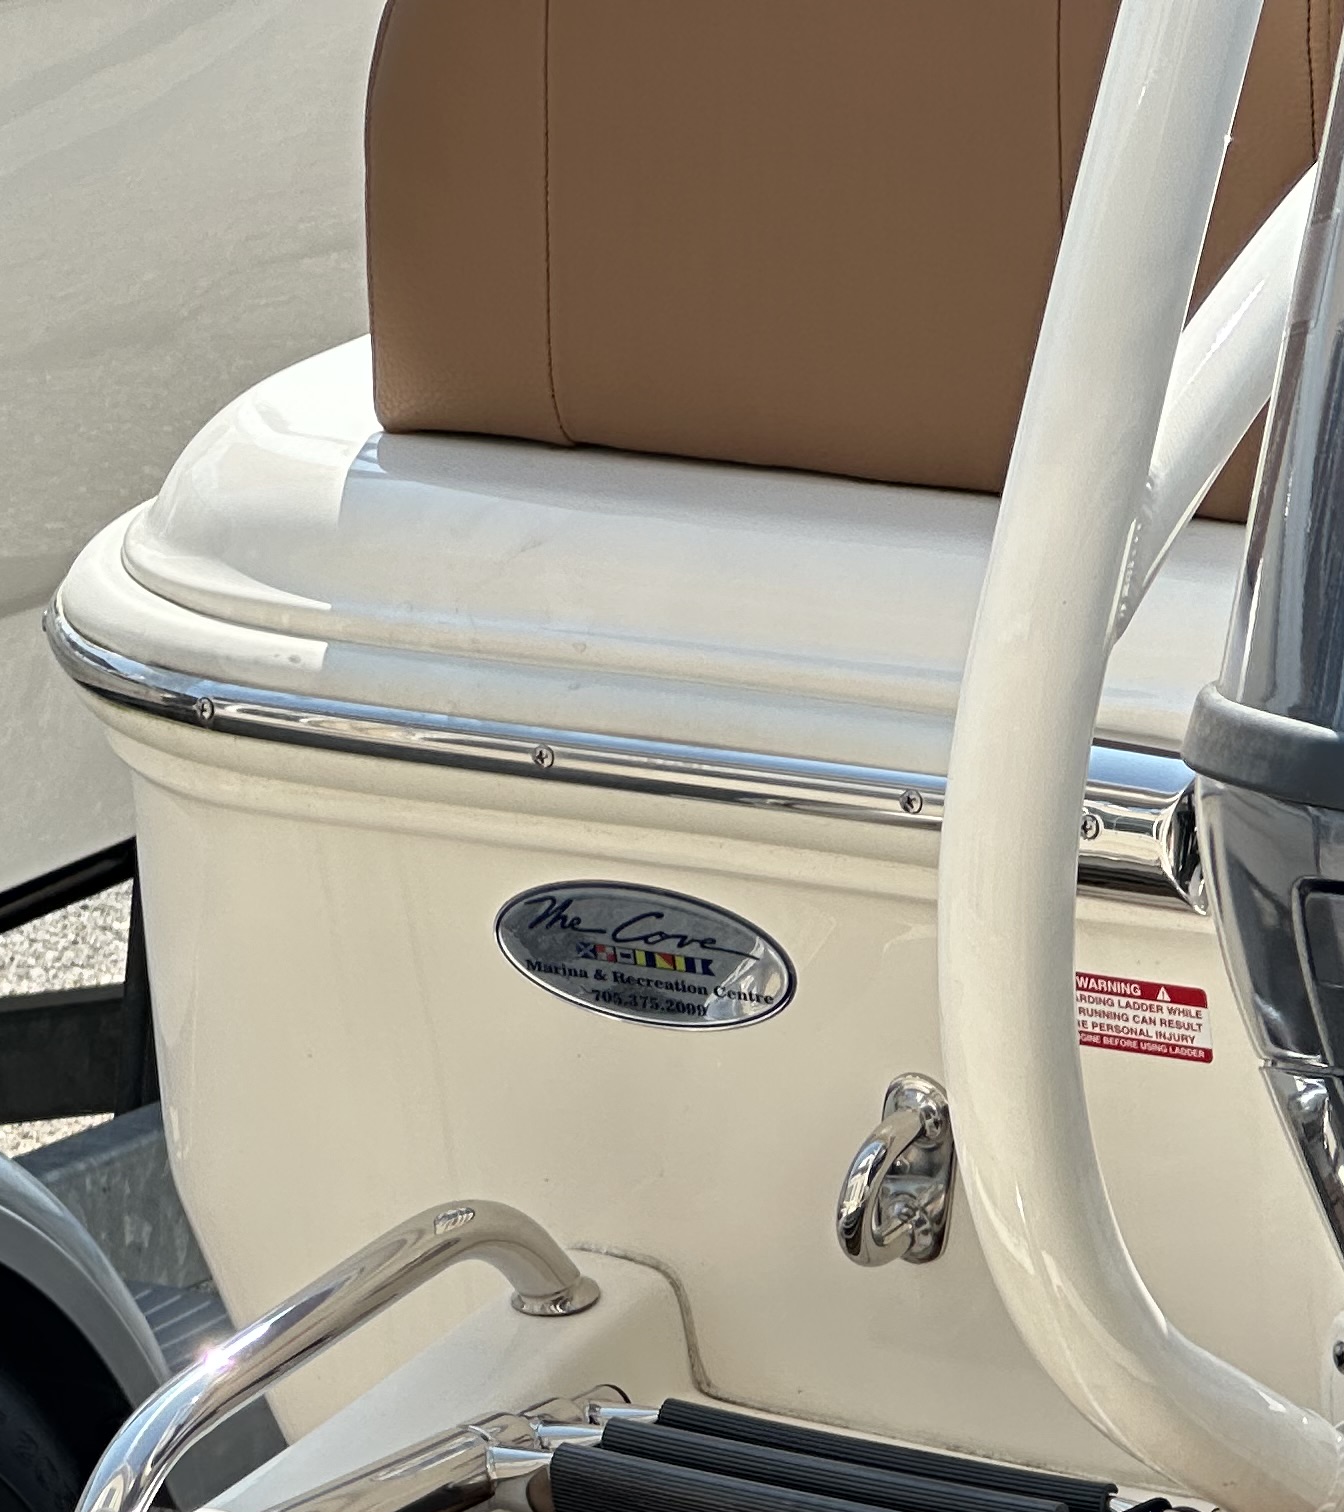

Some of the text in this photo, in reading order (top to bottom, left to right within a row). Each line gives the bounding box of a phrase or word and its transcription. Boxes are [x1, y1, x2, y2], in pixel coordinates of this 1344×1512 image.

[524, 896, 760, 960] The Cove
[525, 958, 774, 1005] Marina & Recreation Centre
[1076, 976, 1141, 996] WARNING
[1078, 1006, 1202, 1032] RUNNING CAN RESULT
[1117, 999, 1164, 1015] LADDER
[1167, 1006, 1202, 1019] WHILE
[1091, 1020, 1153, 1038] PERSONAL
[1155, 1030, 1195, 1045] INJURY
[1102, 1036, 1138, 1049] BEFORE
